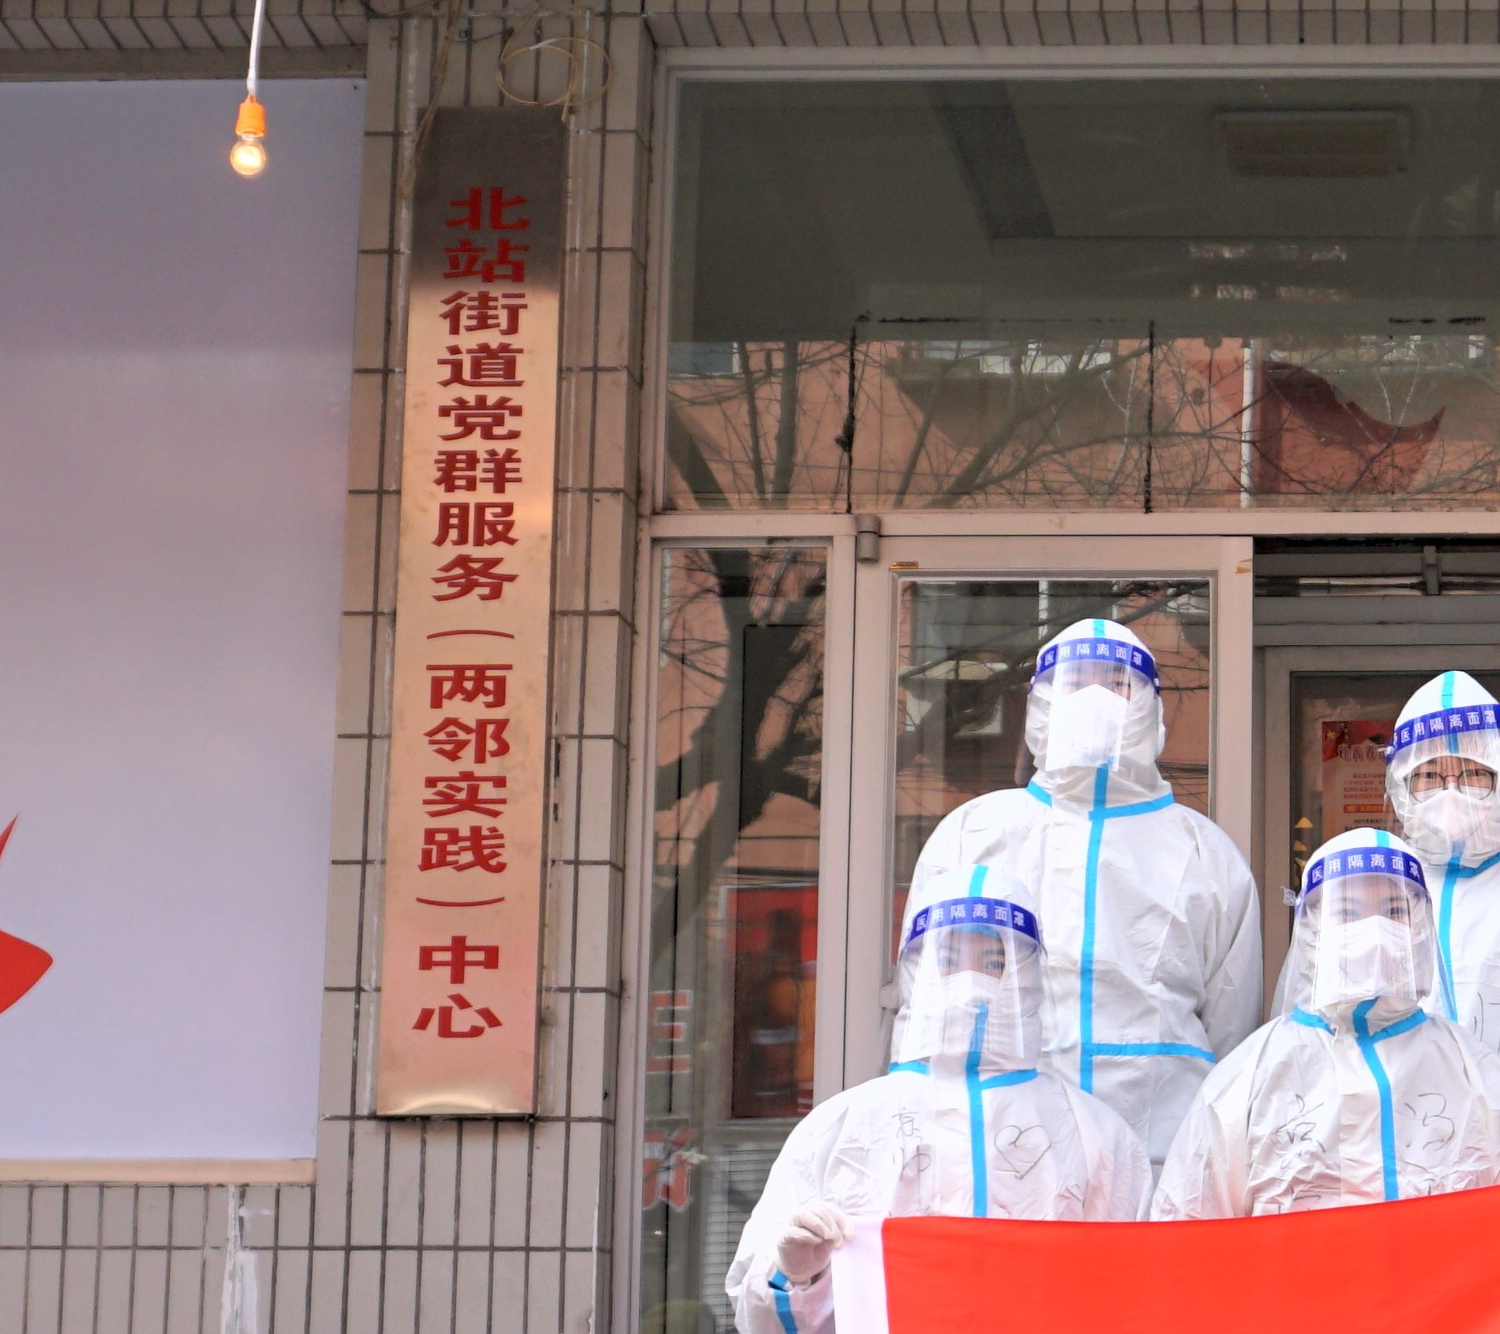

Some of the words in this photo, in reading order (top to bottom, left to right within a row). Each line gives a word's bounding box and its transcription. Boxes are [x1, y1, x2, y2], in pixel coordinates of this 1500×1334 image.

[412, 186, 532, 1039] 北站街道党群服务(两邻实践)中心
[1401, 709, 1496, 744] 医用隔离面罩
[1312, 853, 1421, 884] 医用隔离面罩
[916, 903, 1025, 932] 医用隔离面罩
